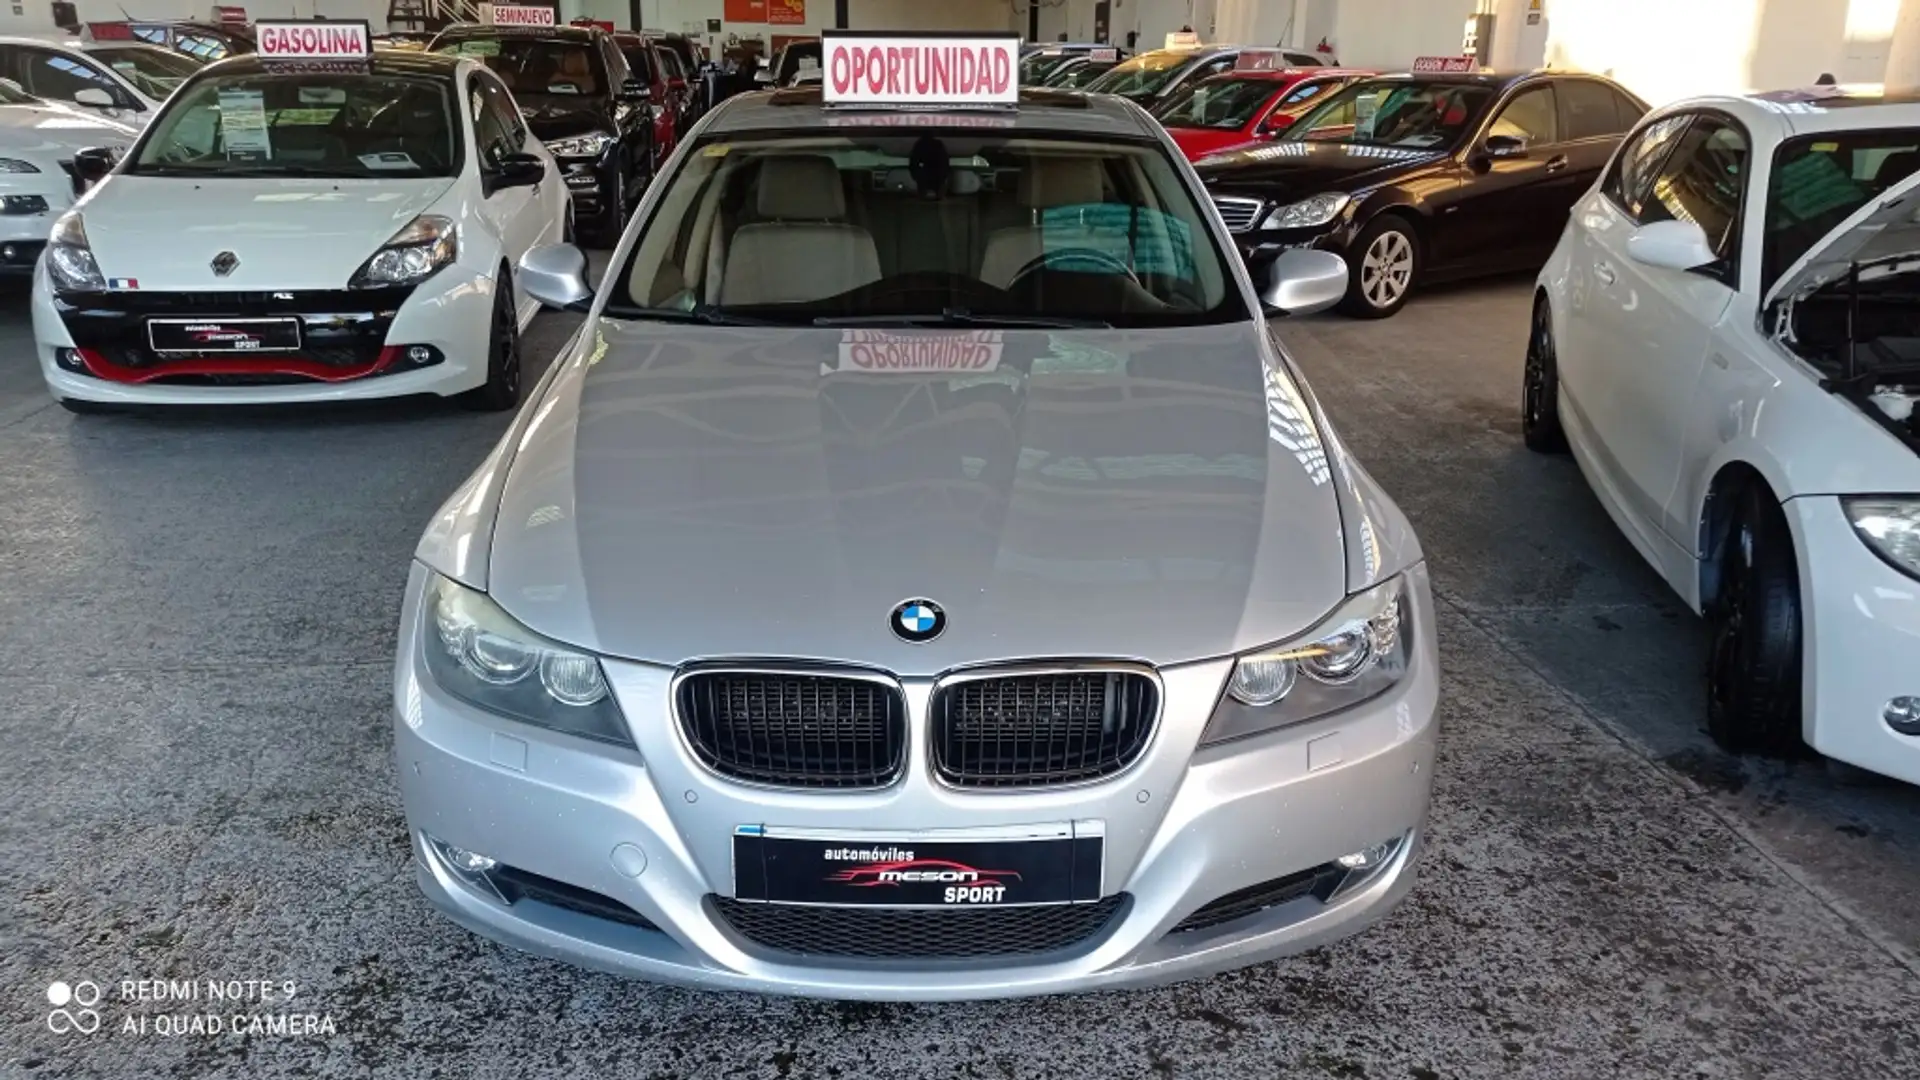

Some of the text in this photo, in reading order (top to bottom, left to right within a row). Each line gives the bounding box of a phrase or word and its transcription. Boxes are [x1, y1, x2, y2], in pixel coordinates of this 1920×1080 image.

[494, 7, 552, 24] SEMINUEVO
[262, 27, 362, 54] GASOLINA
[831, 46, 1010, 94] OPORTUNIDAD
[824, 847, 914, 862] automóviles
[944, 886, 1006, 903] SPORT
